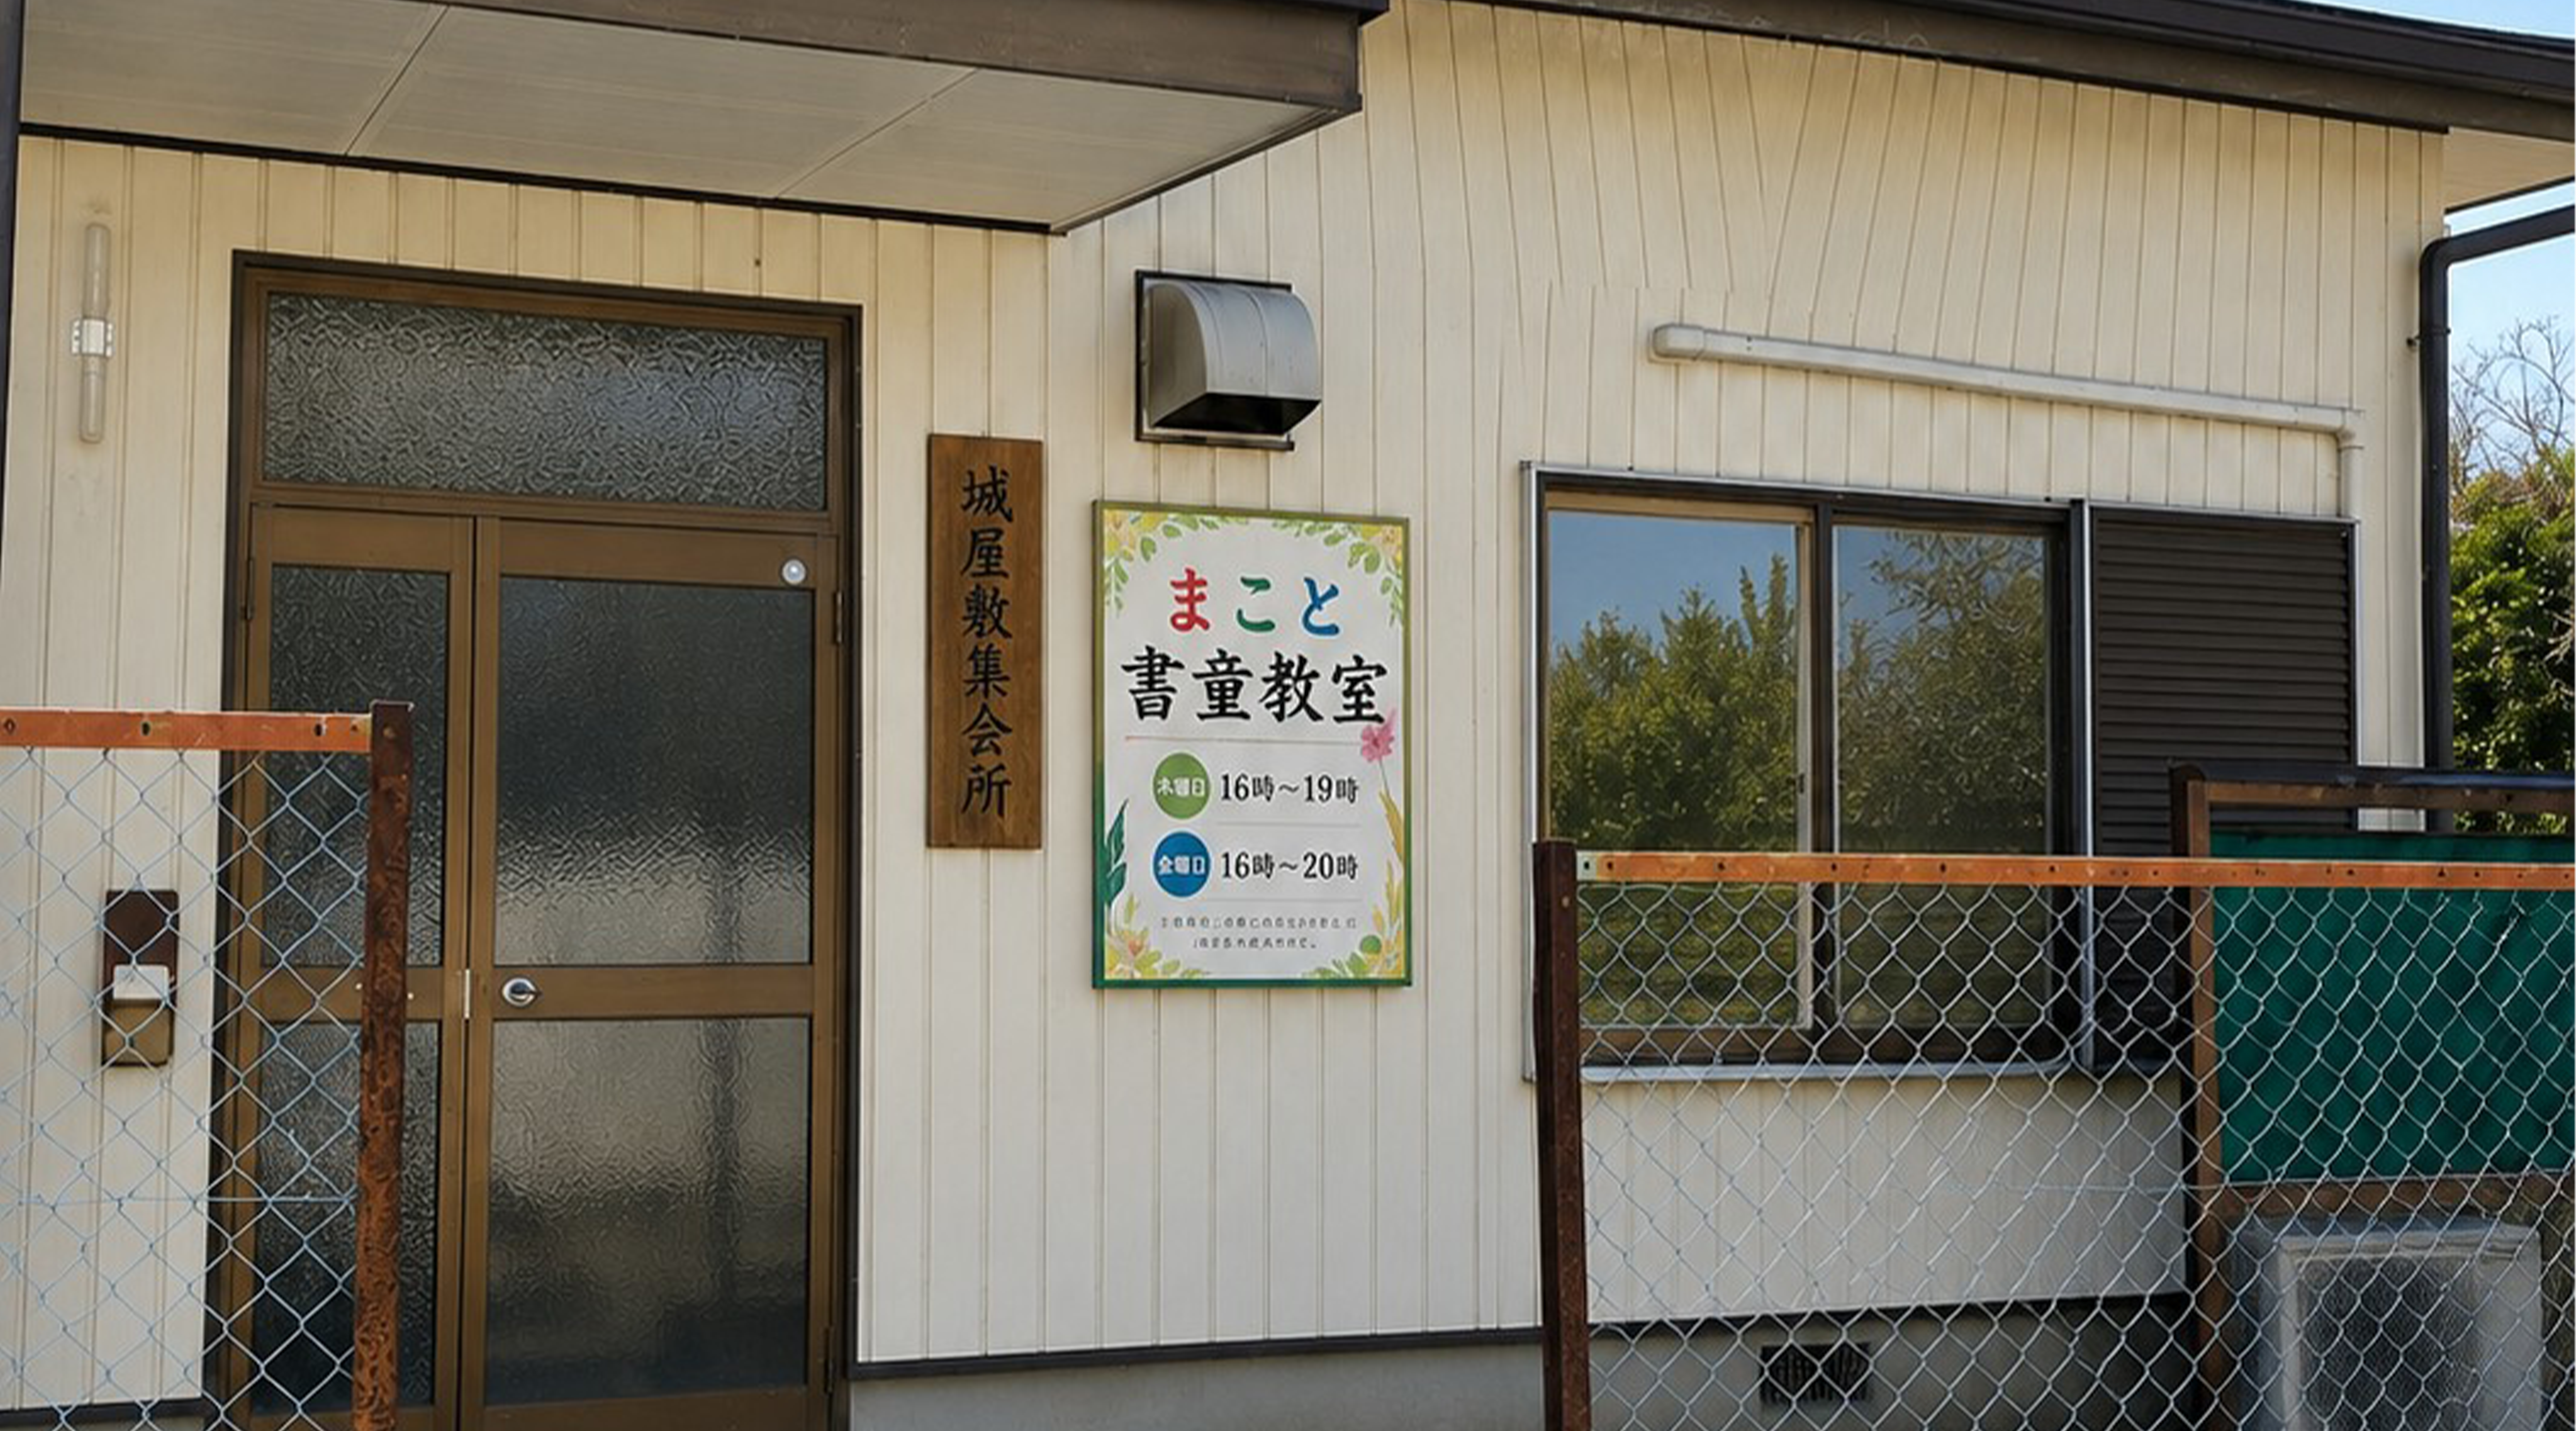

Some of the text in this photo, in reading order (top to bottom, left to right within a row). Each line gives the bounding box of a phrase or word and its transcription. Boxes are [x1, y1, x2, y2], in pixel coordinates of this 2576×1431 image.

[961, 465, 1013, 818] 城屋敷集会所
[1169, 566, 1340, 638] まこと
[1121, 645, 1388, 724] 書童教室
